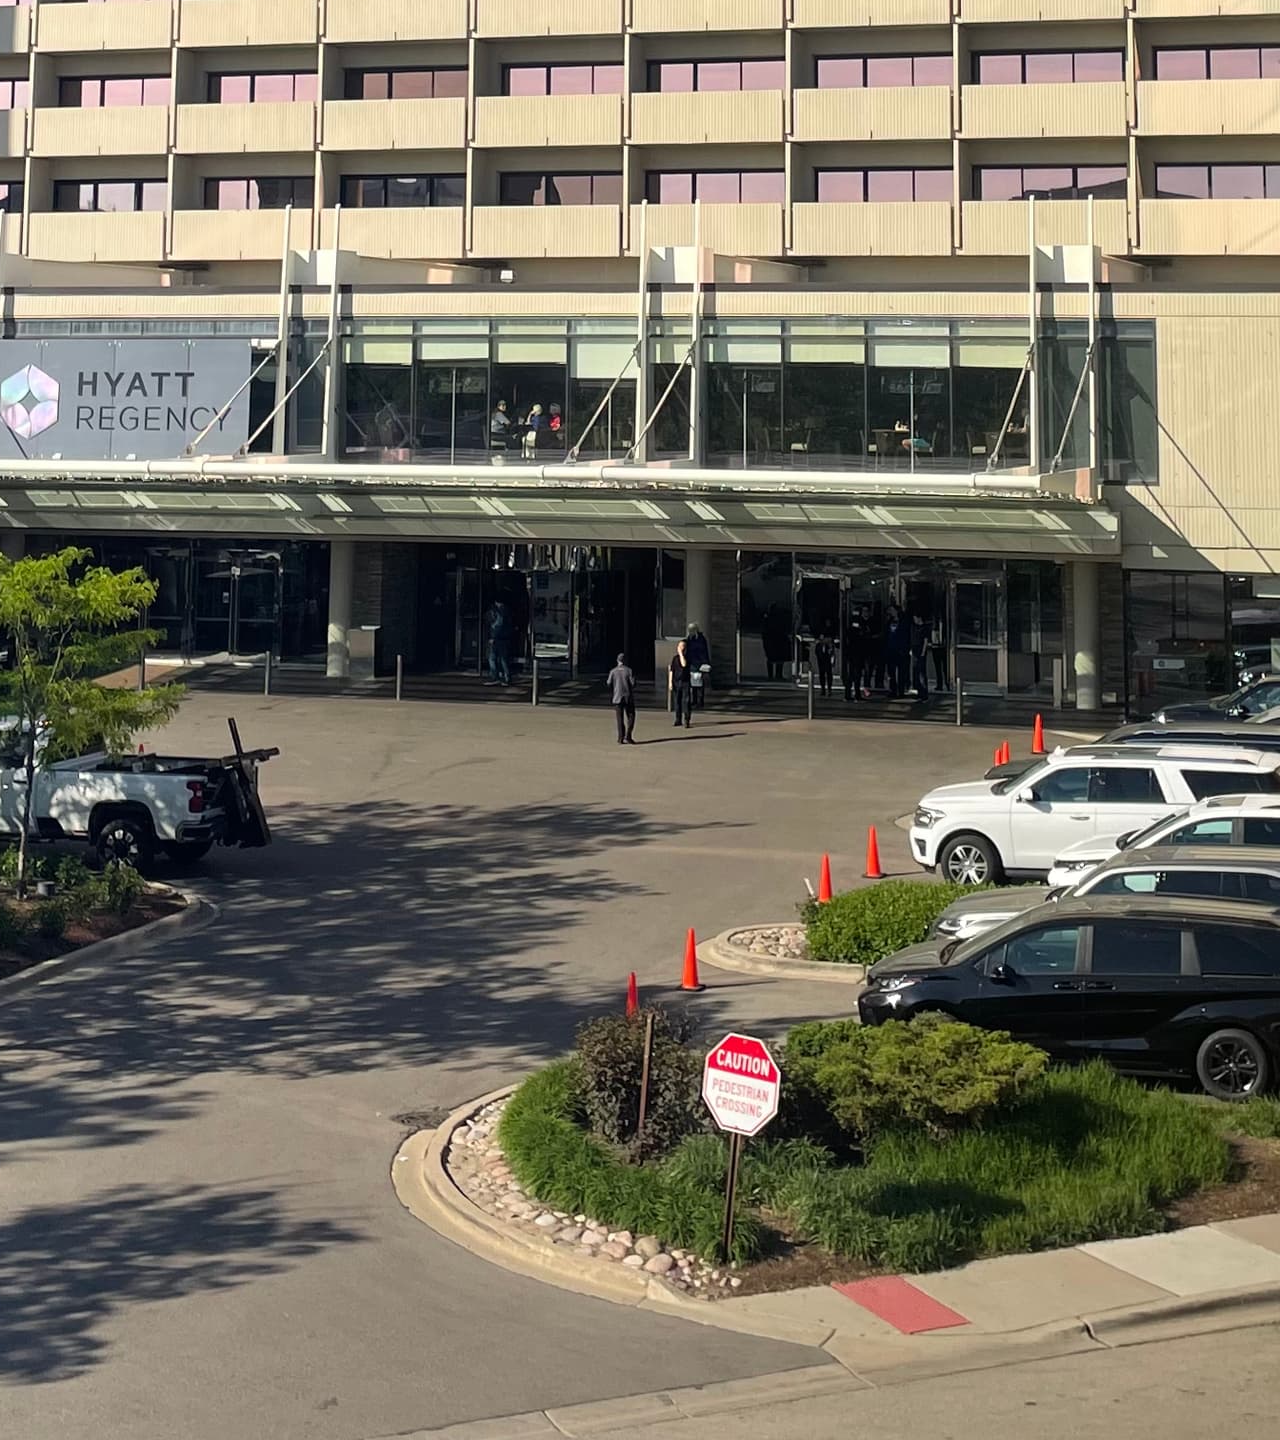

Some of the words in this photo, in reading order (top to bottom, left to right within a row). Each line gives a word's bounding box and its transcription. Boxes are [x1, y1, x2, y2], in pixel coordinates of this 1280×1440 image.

[77, 371, 195, 398] HYATT
[75, 405, 233, 432] REGENCY
[716, 1048, 770, 1077] CAUTION
[712, 1077, 770, 1103] PEDESTRIAN
[715, 1095, 763, 1118] CROSSING
